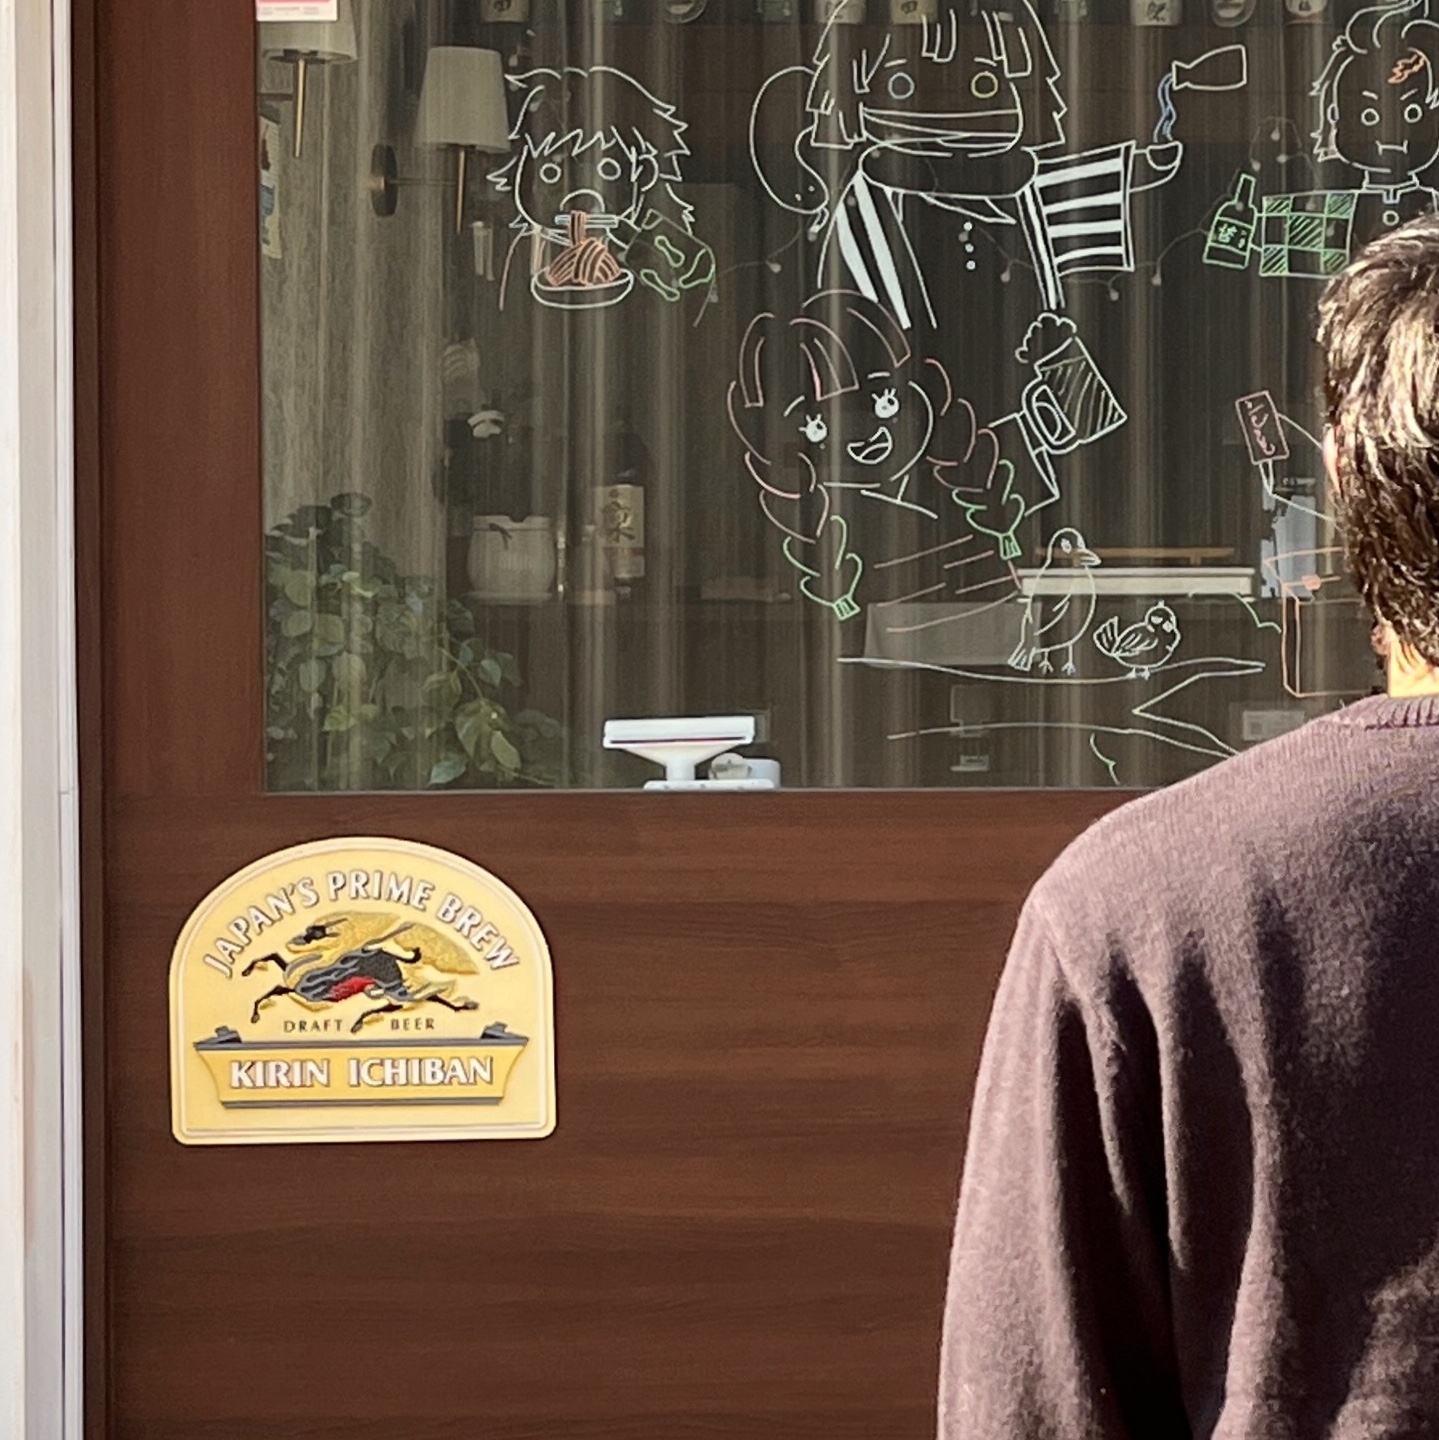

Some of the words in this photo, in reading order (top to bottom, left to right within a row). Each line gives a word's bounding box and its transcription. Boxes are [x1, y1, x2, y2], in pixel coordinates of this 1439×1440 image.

[202, 876, 320, 980] JAPAN'S
[327, 869, 436, 913] PRIME
[436, 891, 521, 972] BREW
[283, 1018, 344, 1034] DRAFT
[390, 1017, 436, 1032] BEER
[230, 1058, 331, 1089] KIRIN
[348, 1056, 493, 1088] ICHIBAN
